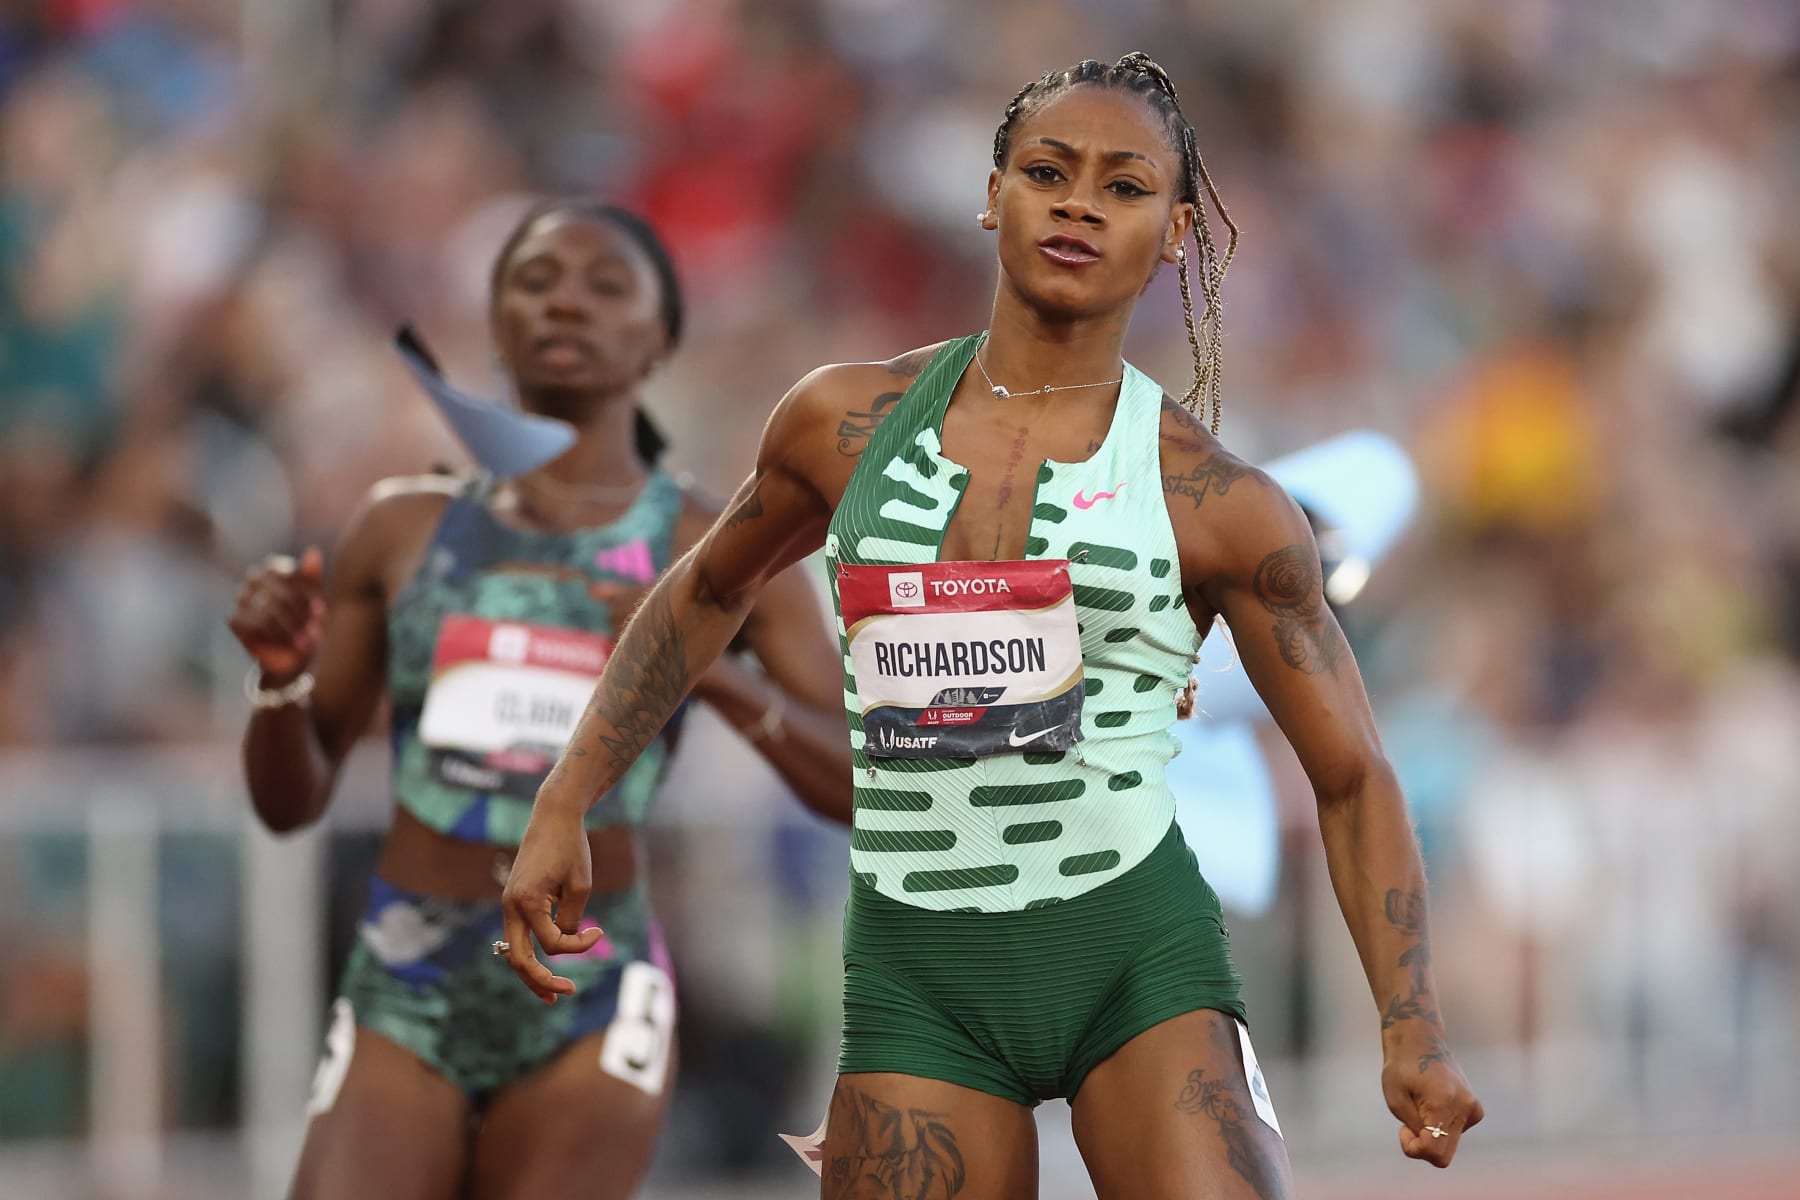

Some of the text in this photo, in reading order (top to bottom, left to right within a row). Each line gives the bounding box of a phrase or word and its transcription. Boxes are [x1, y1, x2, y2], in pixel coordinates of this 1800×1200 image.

[931, 579, 1011, 596] TOYOTA
[875, 638, 1046, 677] RICHARDSON
[896, 736, 938, 749] USATF
